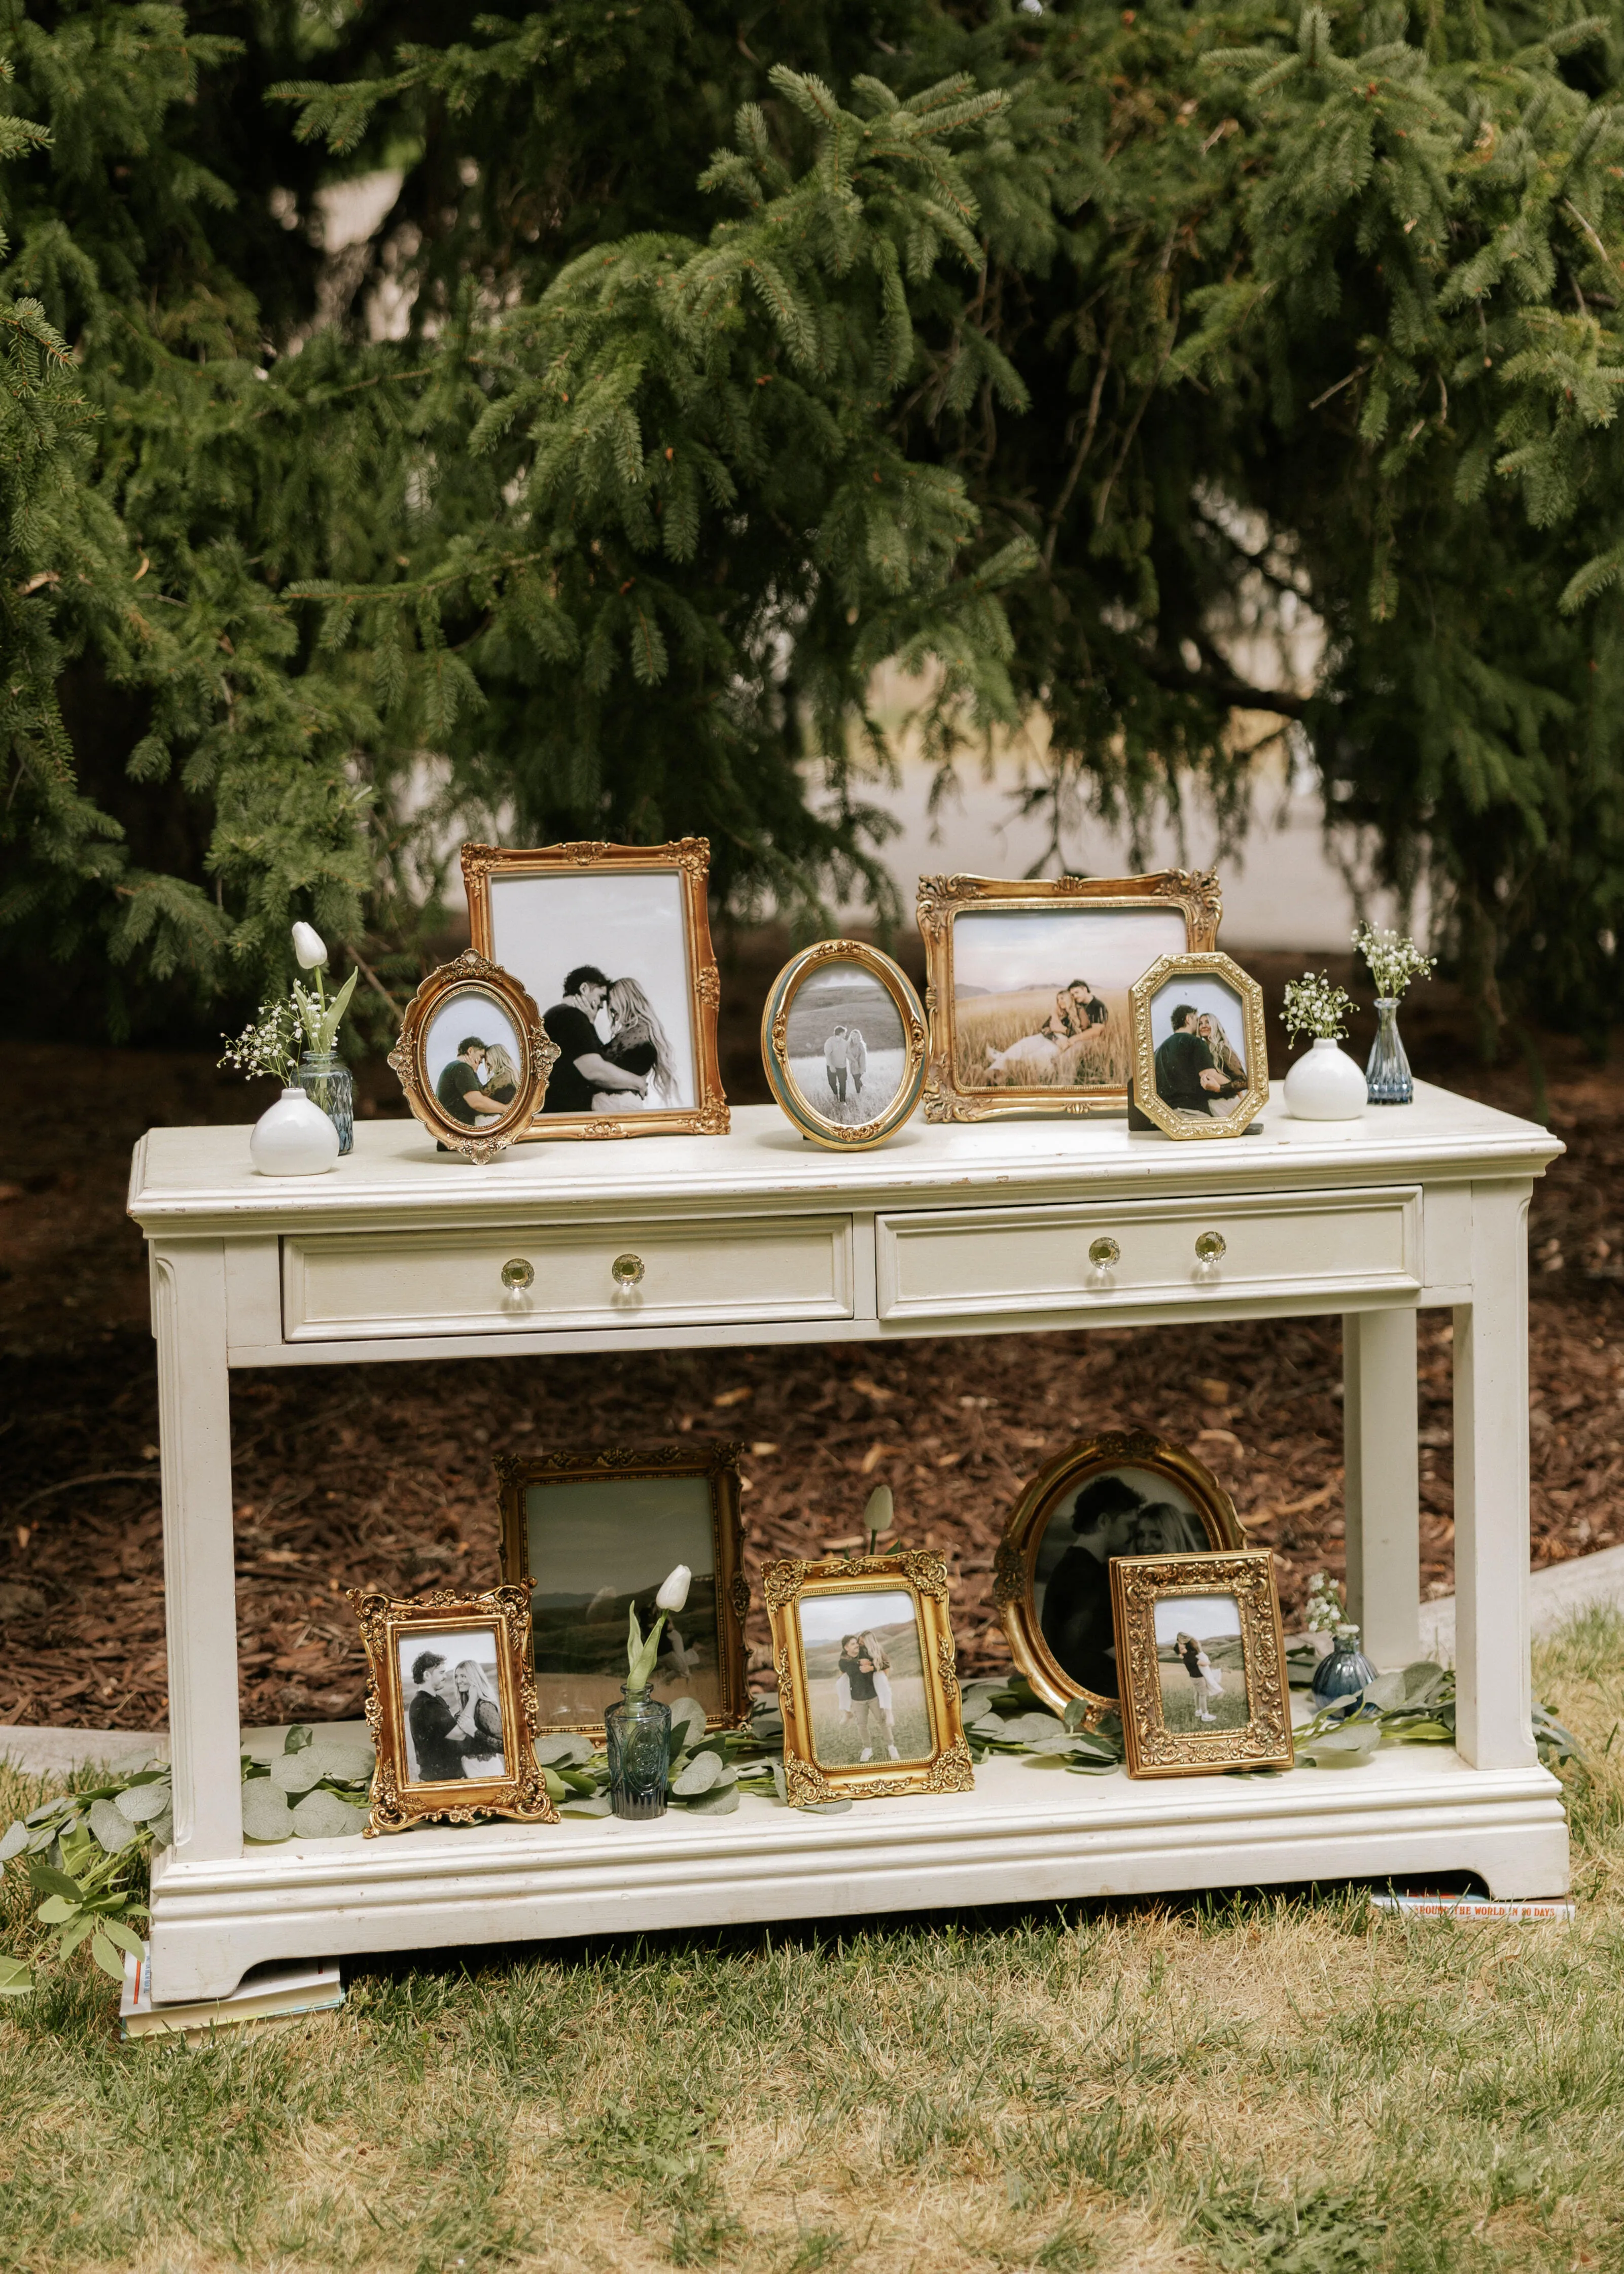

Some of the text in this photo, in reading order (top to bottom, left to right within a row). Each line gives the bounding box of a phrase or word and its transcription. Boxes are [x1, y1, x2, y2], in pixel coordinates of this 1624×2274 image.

[1454, 1906, 1471, 1915] THE
[1474, 1906, 1505, 1916] WORLD
[1509, 1907, 1518, 1916] N
[1522, 1907, 1532, 1916] 80
[1534, 1907, 1555, 1916] DAYS
